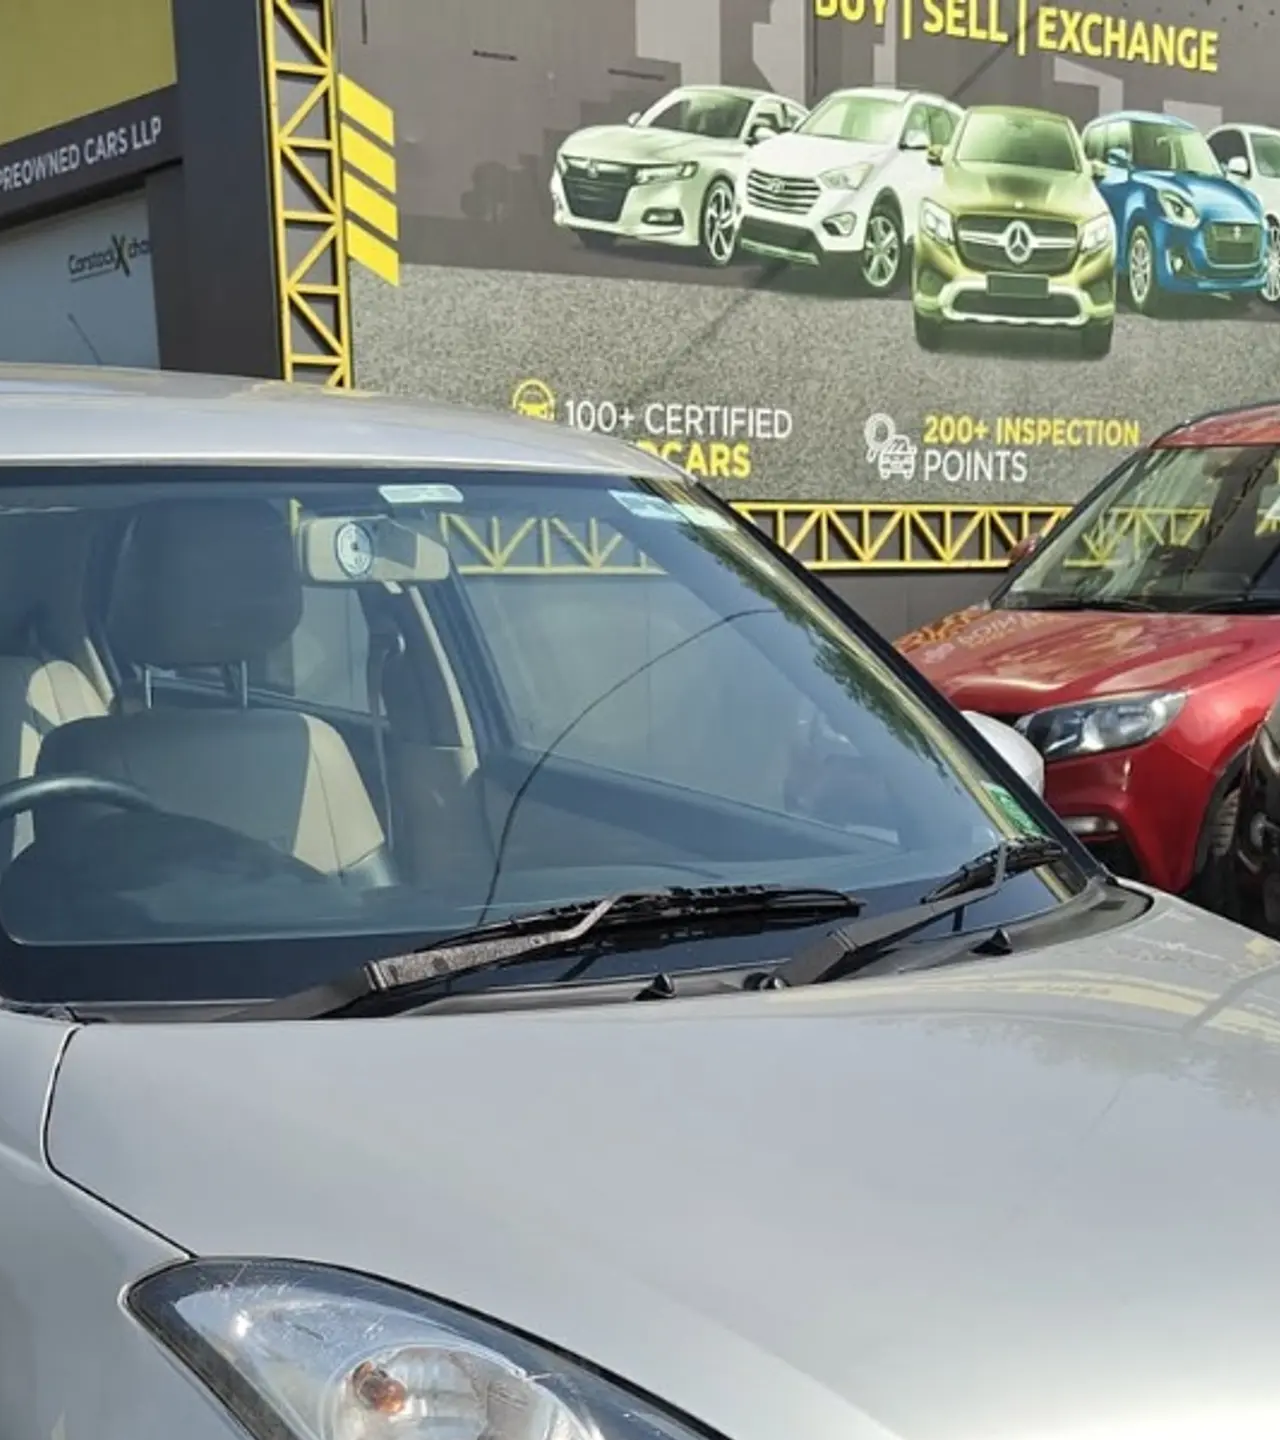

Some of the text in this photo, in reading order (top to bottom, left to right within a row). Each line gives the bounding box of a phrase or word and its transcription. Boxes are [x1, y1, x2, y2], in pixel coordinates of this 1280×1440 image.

[923, 0, 1009, 43] SELL
[1037, 7, 1218, 72] EXCHANGE
[83, 128, 128, 165] CARS
[131, 115, 162, 150] LLP
[565, 400, 793, 439] 100+ CERTIFIED
[923, 414, 1141, 447] 200+ INSPECTION
[923, 449, 1028, 482] POINTS
